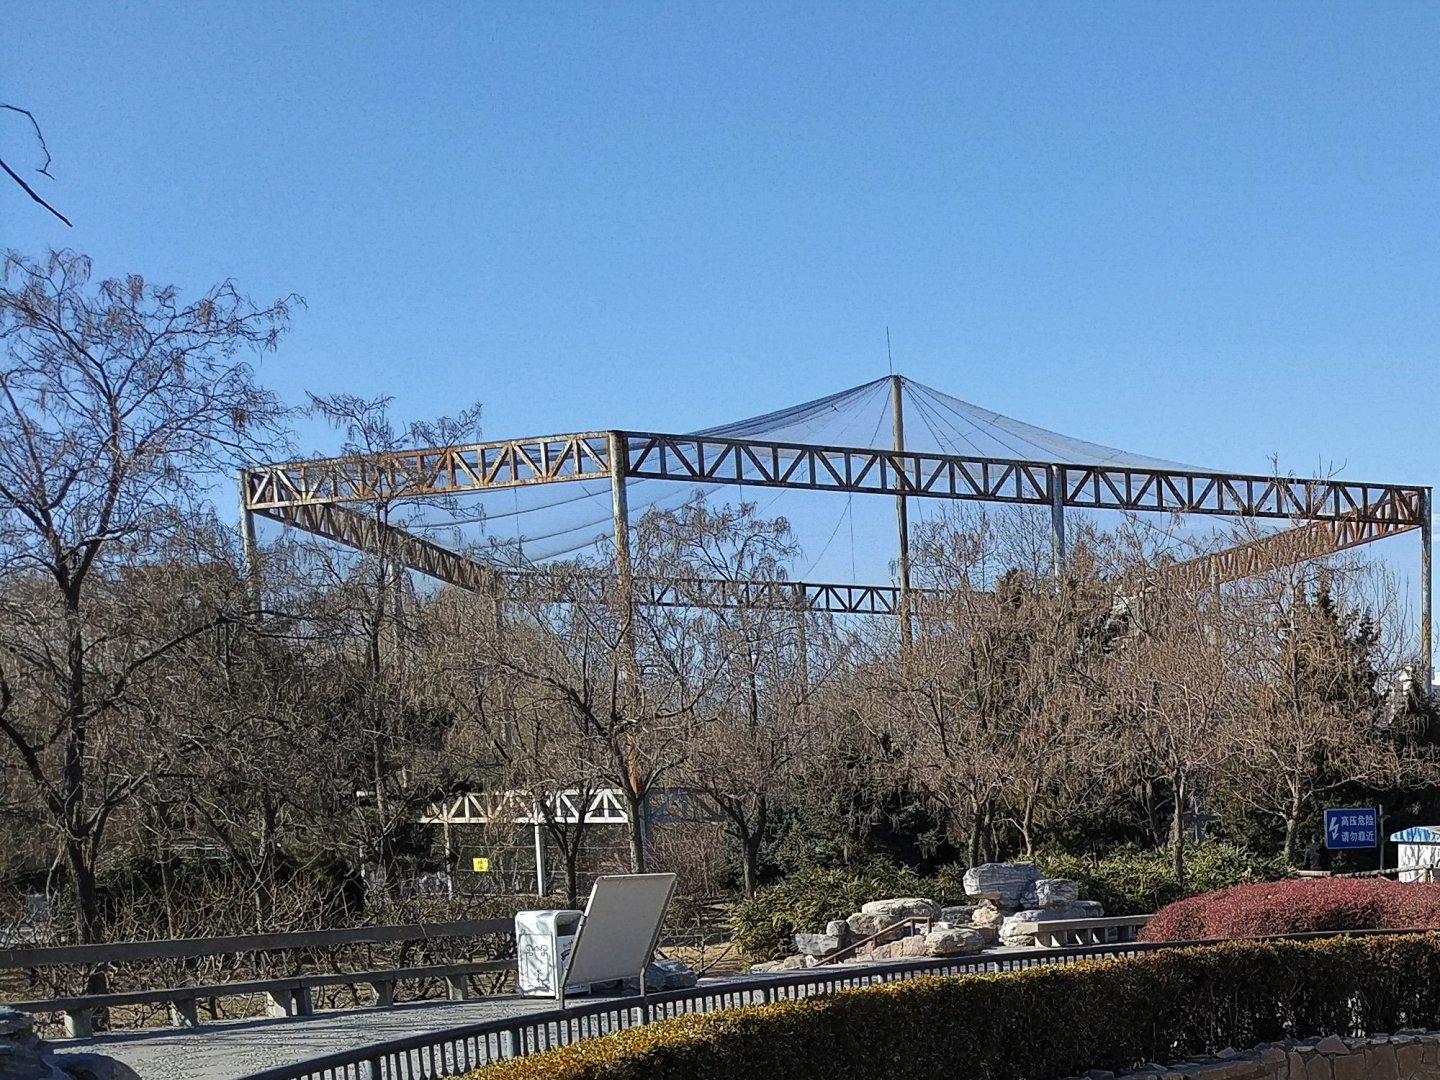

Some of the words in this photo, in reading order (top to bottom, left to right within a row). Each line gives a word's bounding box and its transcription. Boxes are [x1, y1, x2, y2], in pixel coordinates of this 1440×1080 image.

[1341, 815, 1374, 826] 高压危险
[1341, 831, 1374, 842] 请勿靠近
